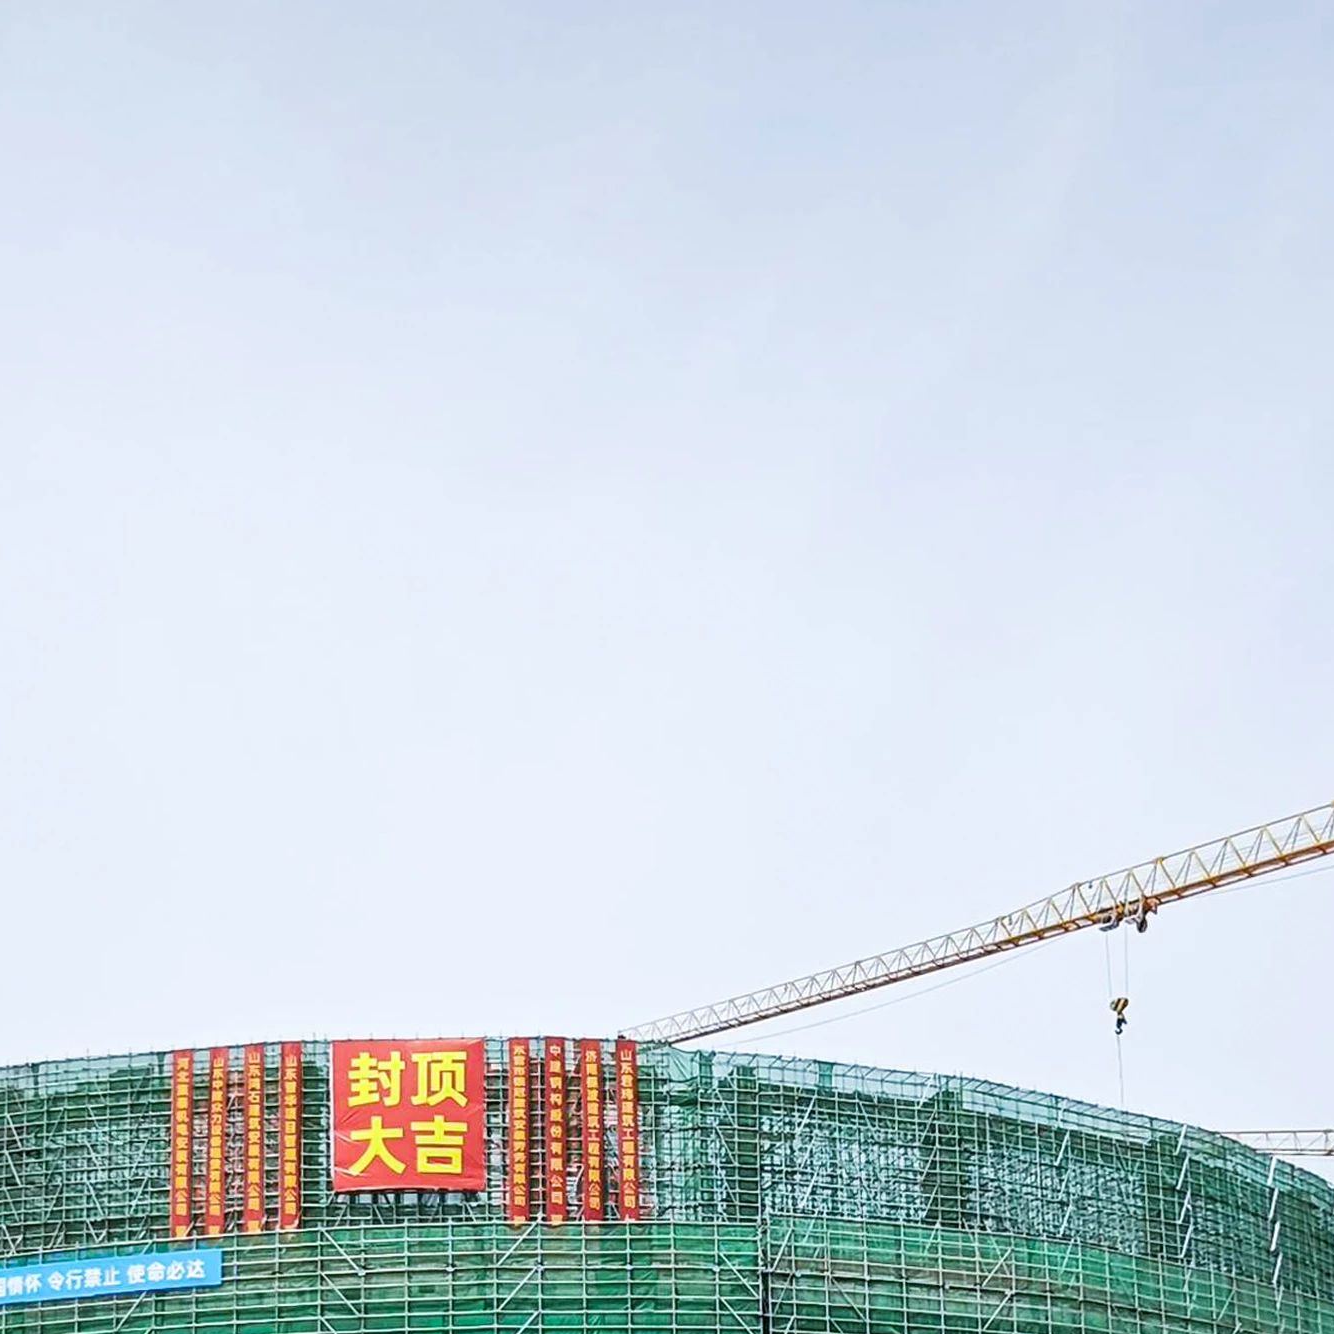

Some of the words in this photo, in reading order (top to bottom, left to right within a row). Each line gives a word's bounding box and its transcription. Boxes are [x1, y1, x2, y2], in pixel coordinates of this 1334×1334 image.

[347, 1050, 468, 1108] 封顶
[347, 1118, 466, 1176] 大吉
[47, 1267, 121, 1291] 令行禁止
[126, 1260, 205, 1285] 使命必达
